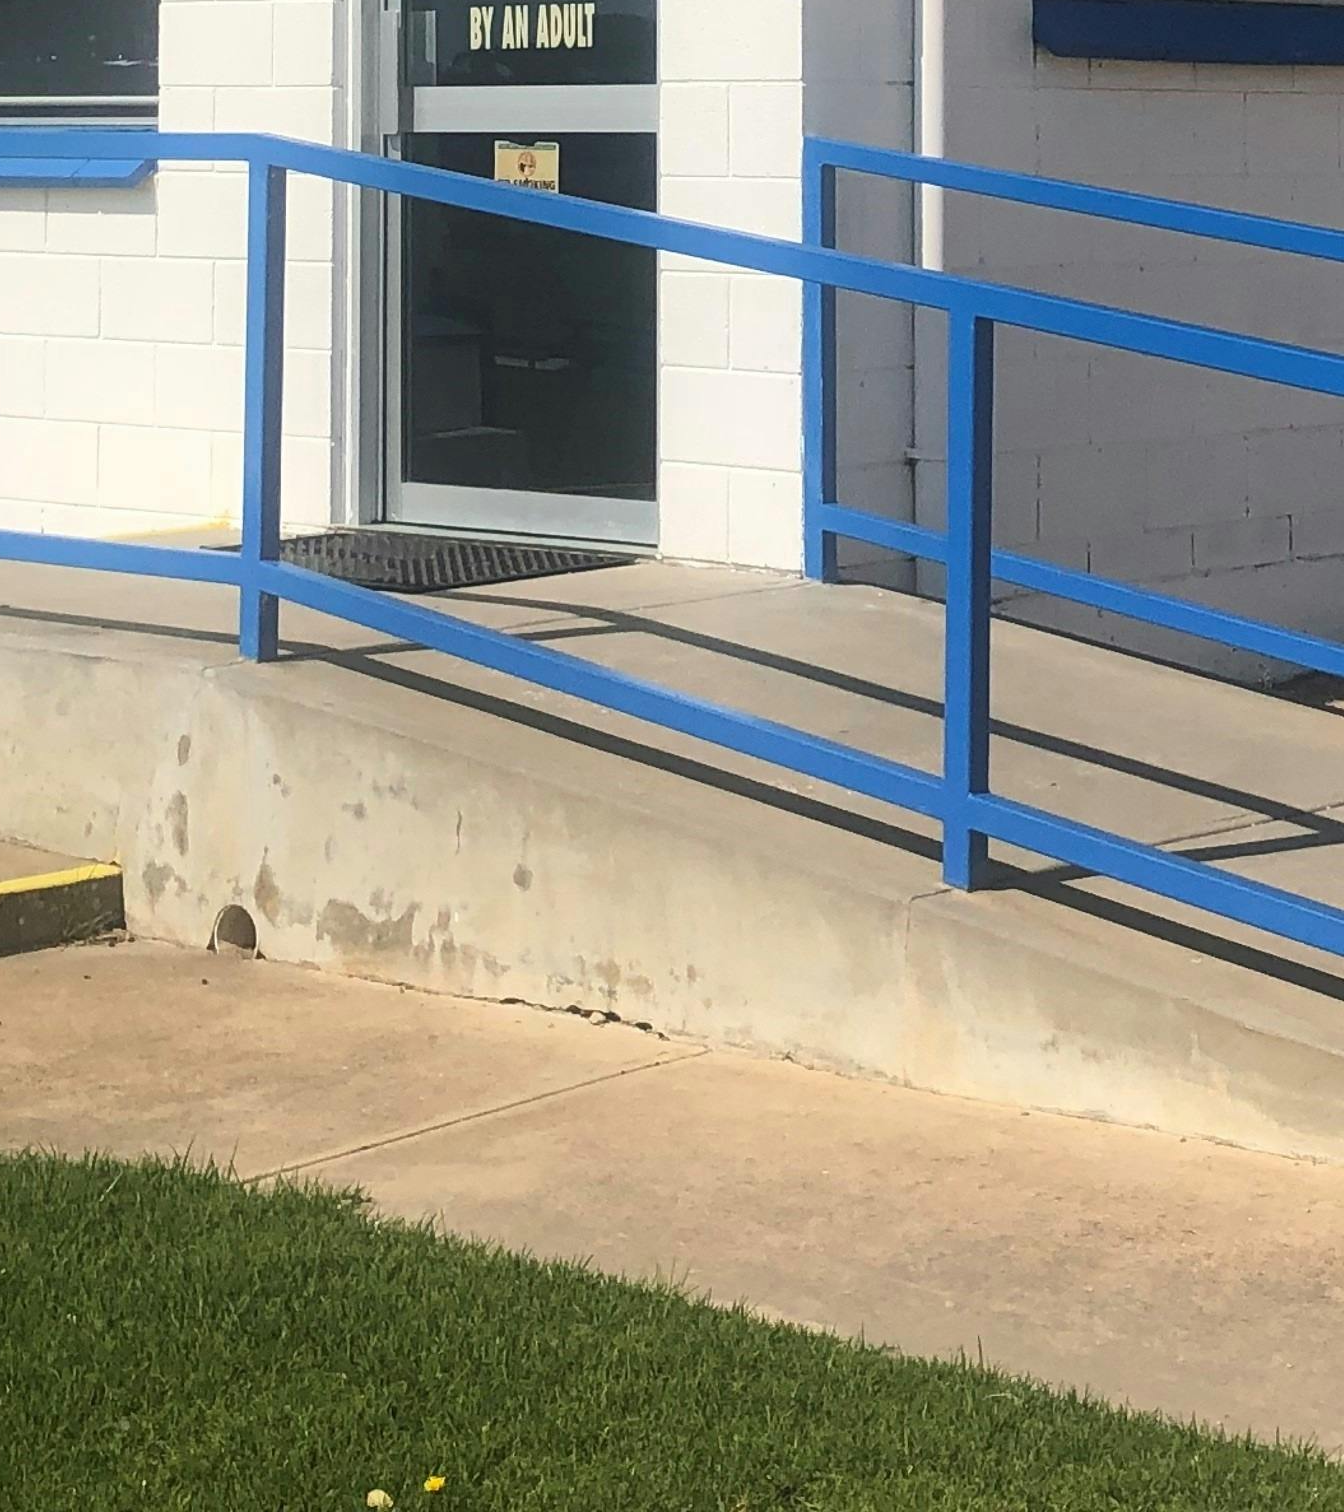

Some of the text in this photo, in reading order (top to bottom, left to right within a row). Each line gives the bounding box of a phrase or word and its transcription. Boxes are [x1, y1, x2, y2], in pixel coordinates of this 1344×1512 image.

[469, 3, 596, 51] BY AN ADULT
